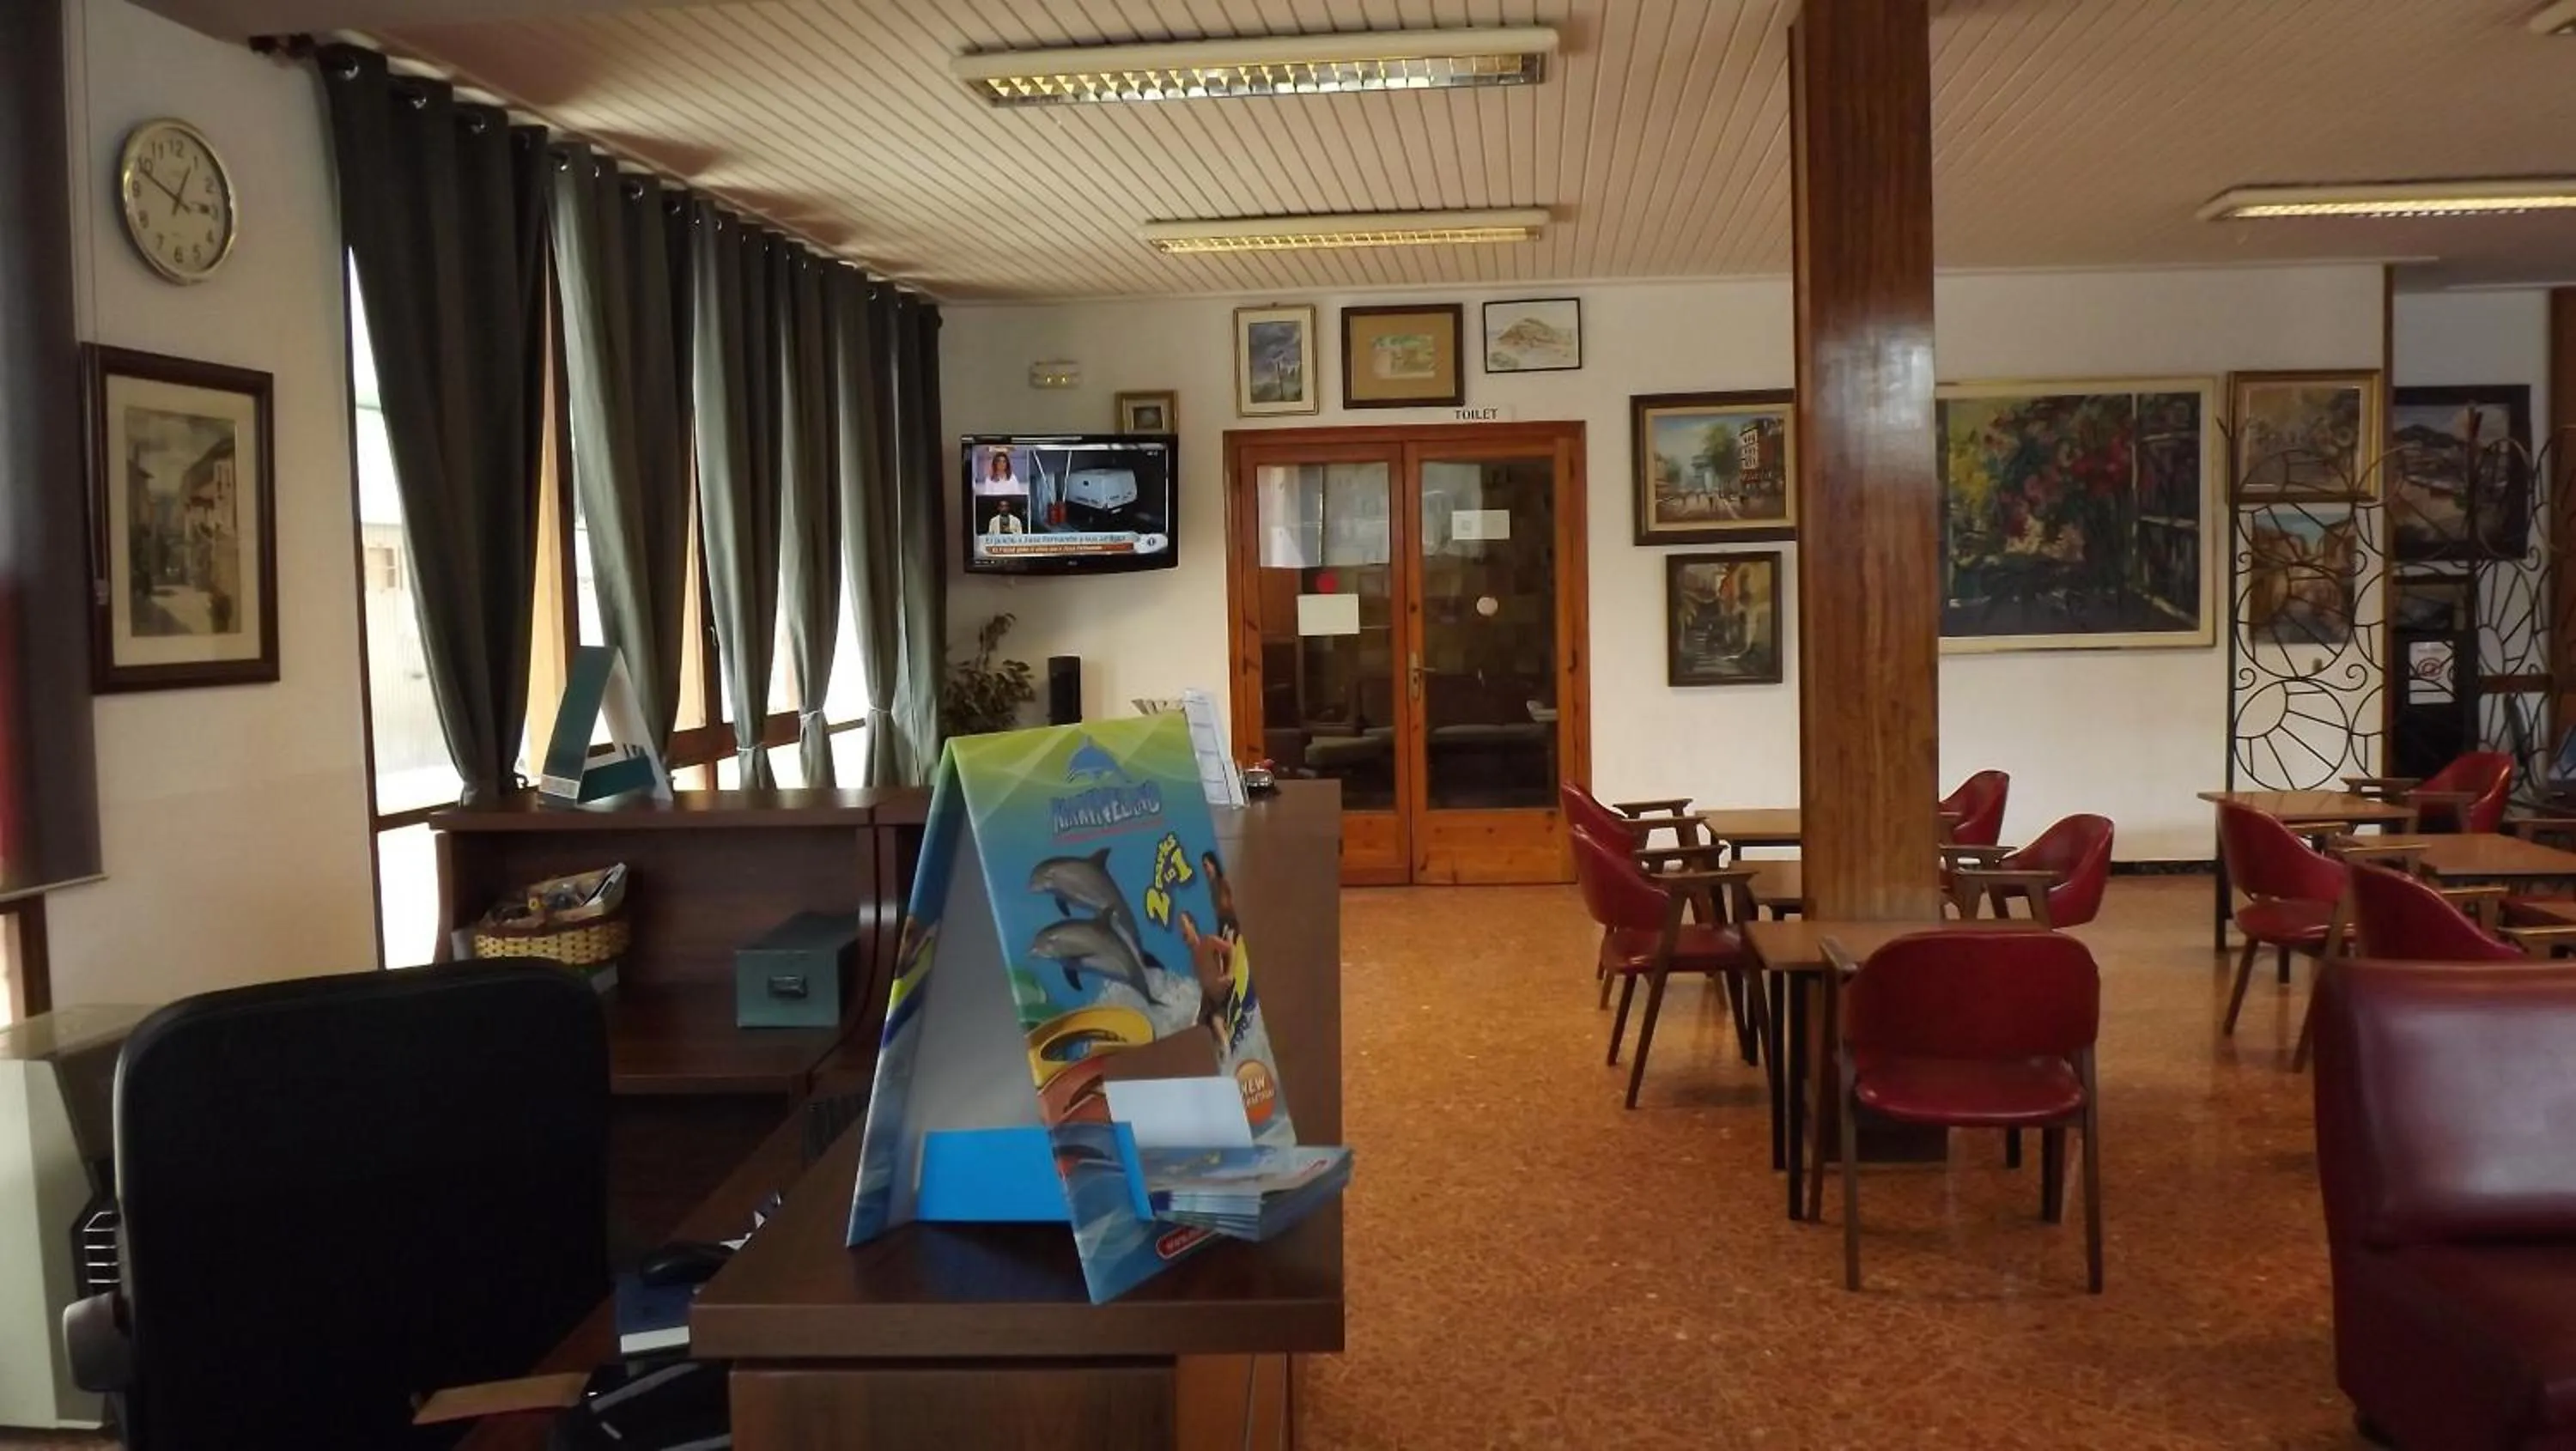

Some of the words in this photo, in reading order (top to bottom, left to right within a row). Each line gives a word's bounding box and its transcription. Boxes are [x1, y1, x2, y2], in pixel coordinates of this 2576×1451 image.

[151, 142, 164, 160] 11
[170, 140, 184, 158] 12
[138, 156, 154, 173] 10
[193, 155, 198, 170] 1
[132, 180, 141, 198] 9
[204, 177, 214, 193] 2
[139, 210, 149, 229] 8
[156, 233, 165, 250] 7
[205, 229, 214, 244] 4
[174, 246, 184, 264] 6
[192, 244, 201, 260] 5
[1454, 408, 1498, 420] TOILET
